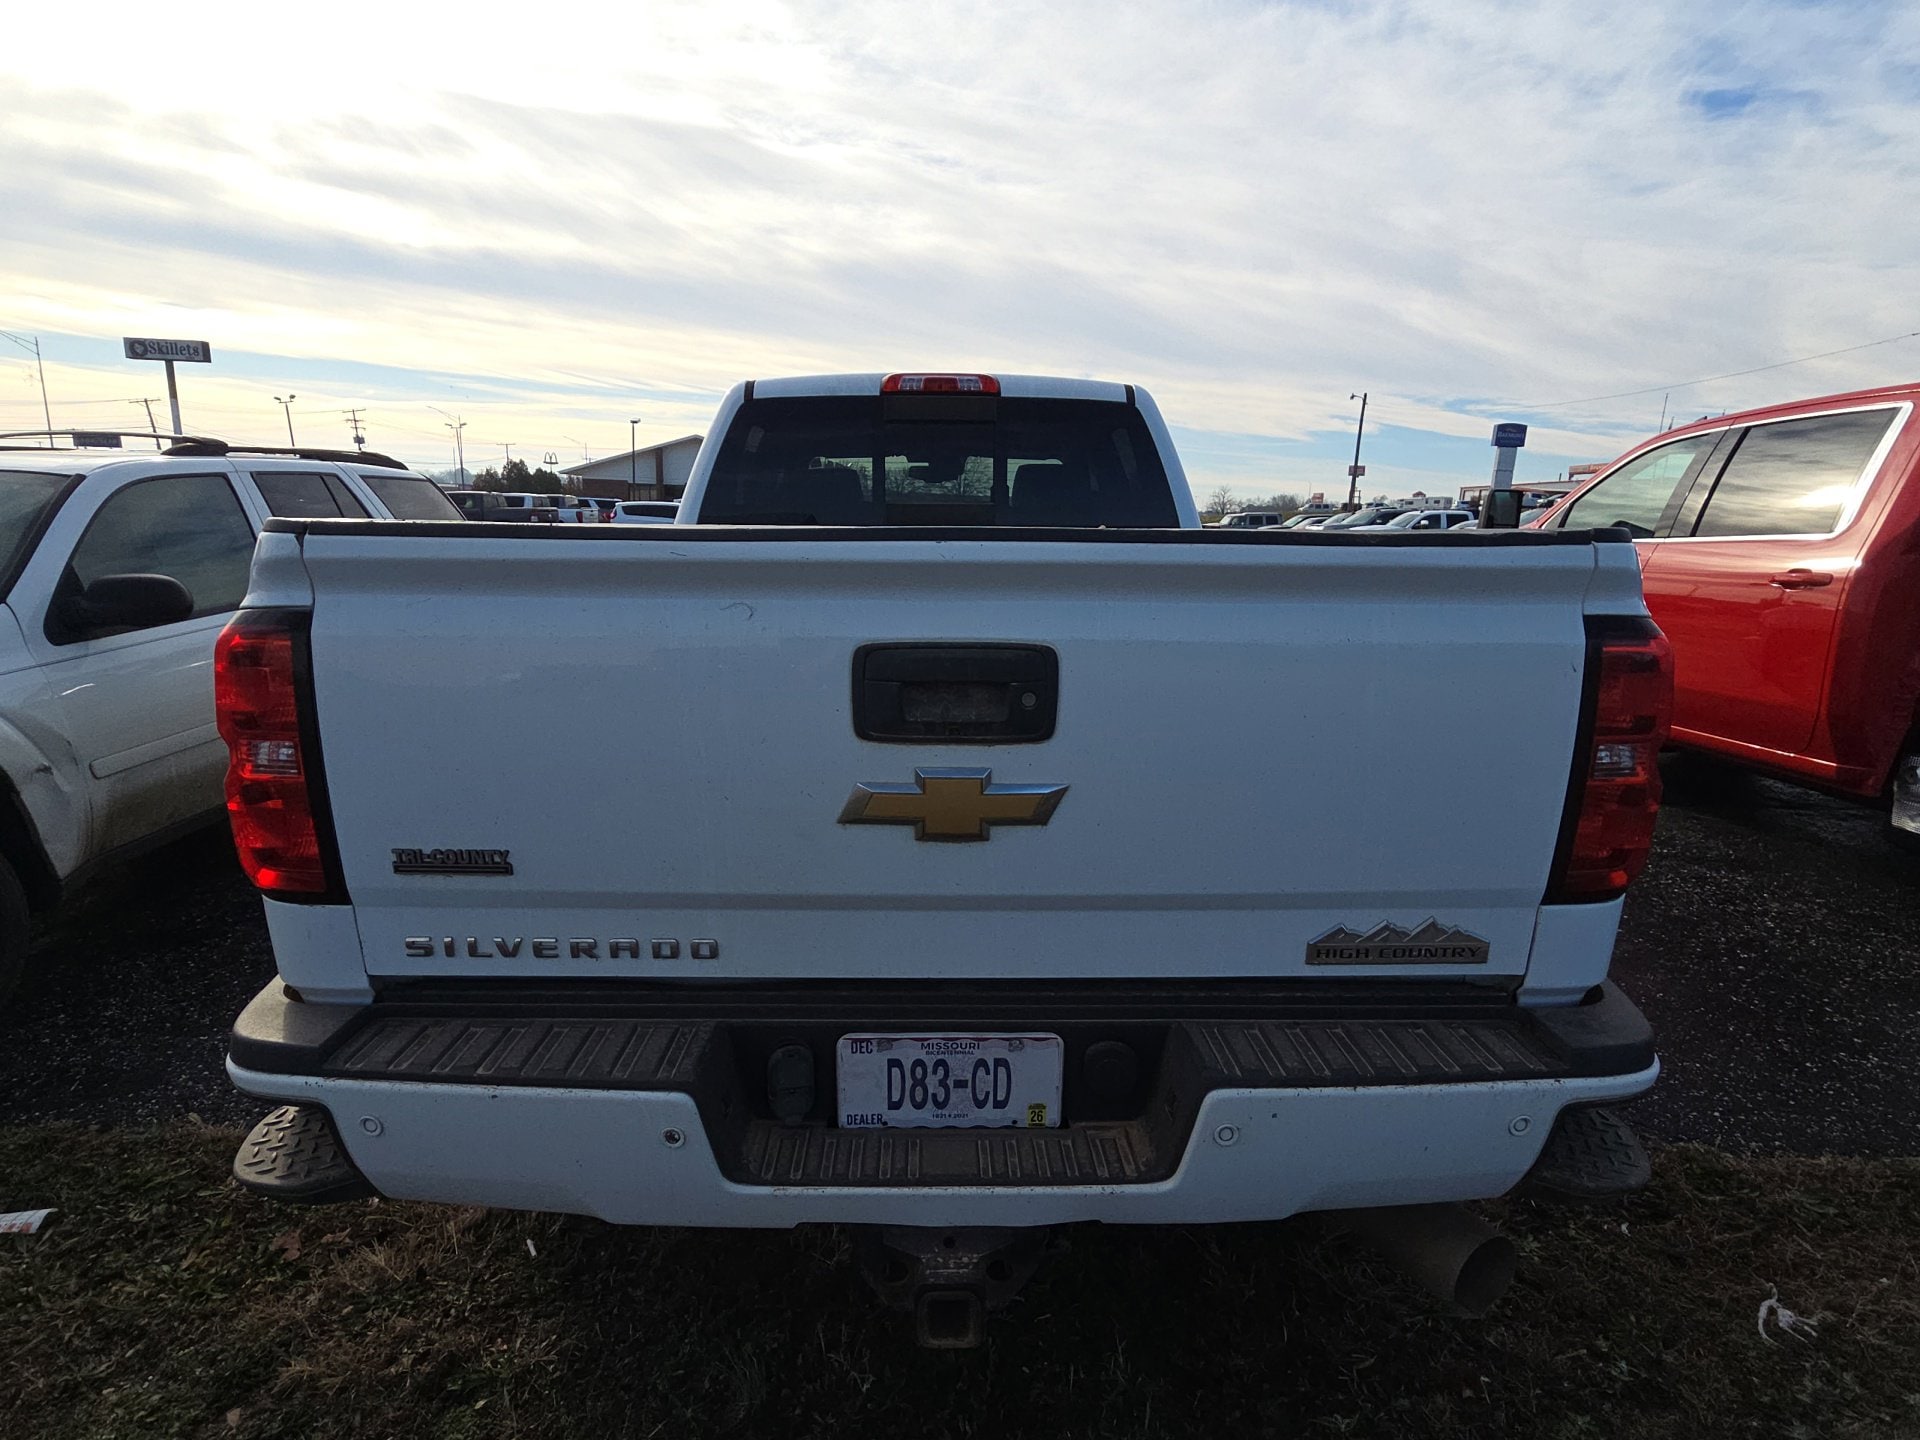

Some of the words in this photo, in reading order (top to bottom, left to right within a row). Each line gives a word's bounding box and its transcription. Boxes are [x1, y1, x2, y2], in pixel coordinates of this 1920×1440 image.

[148, 341, 199, 356] Skillets
[391, 848, 510, 865] TRI-COUNTY
[405, 936, 719, 960] SILVERADO
[1316, 947, 1369, 959] HIGH
[1378, 946, 1481, 959] COUNTRY
[850, 1040, 873, 1055] DEC
[920, 1042, 980, 1050] MISSOURI
[887, 1058, 1012, 1110] D83-CD
[846, 1113, 884, 1126] DEALER
[1030, 1110, 1044, 1123] 26
